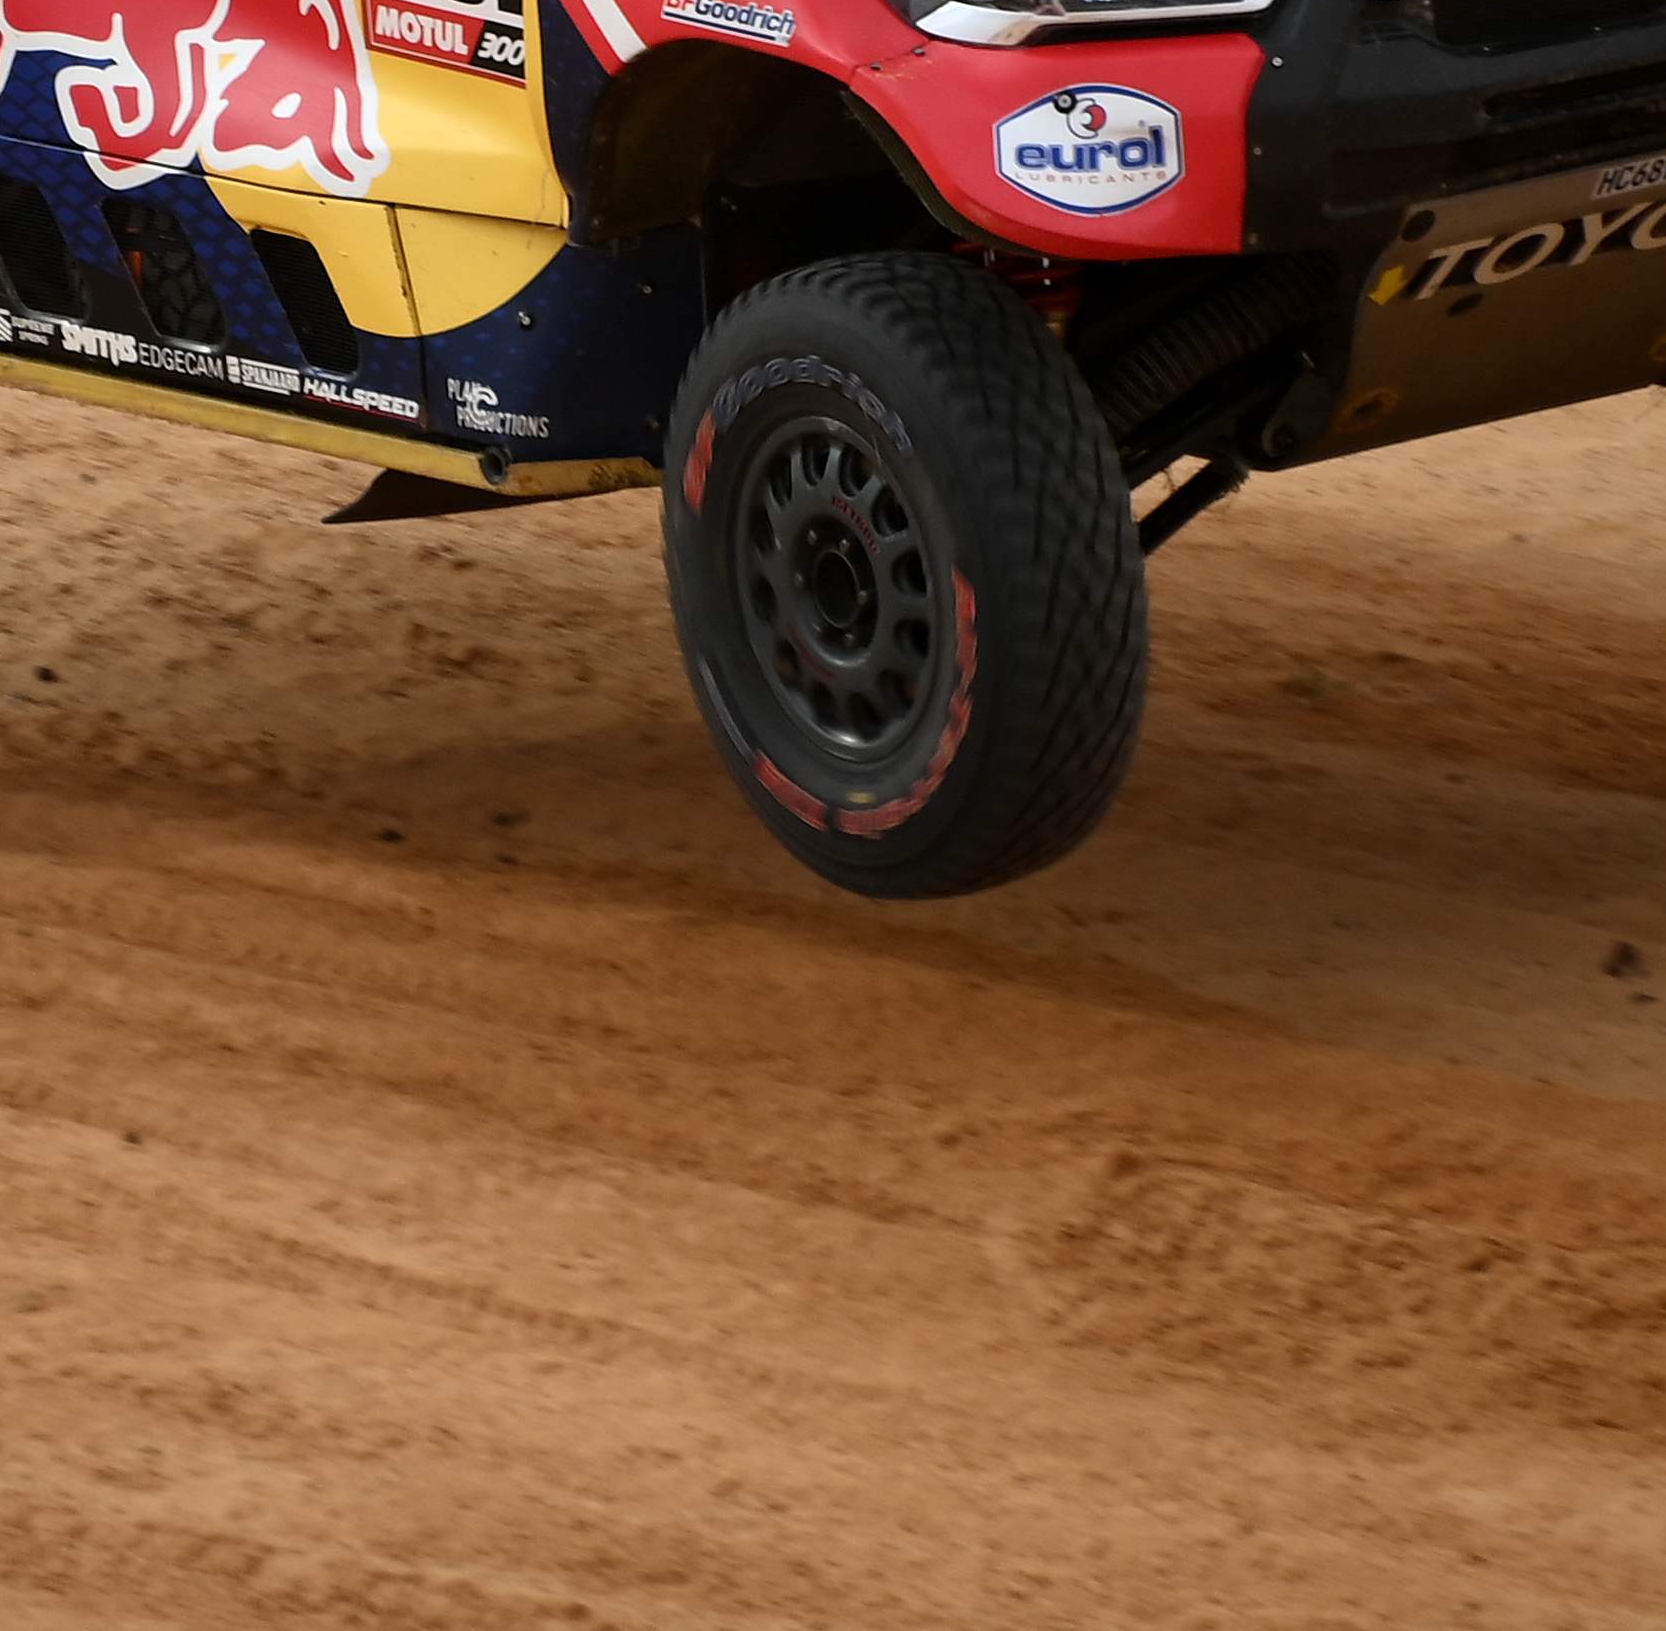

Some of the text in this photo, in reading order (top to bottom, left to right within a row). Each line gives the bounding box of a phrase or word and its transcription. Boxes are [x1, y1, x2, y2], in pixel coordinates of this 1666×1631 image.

[375, 5, 525, 66] MOTUL 300
[1015, 124, 1167, 173] eurol
[1014, 170, 1169, 185] LUBRICANTS
[138, 342, 225, 381] EDGECAM
[302, 377, 420, 419] HALLSPEED
